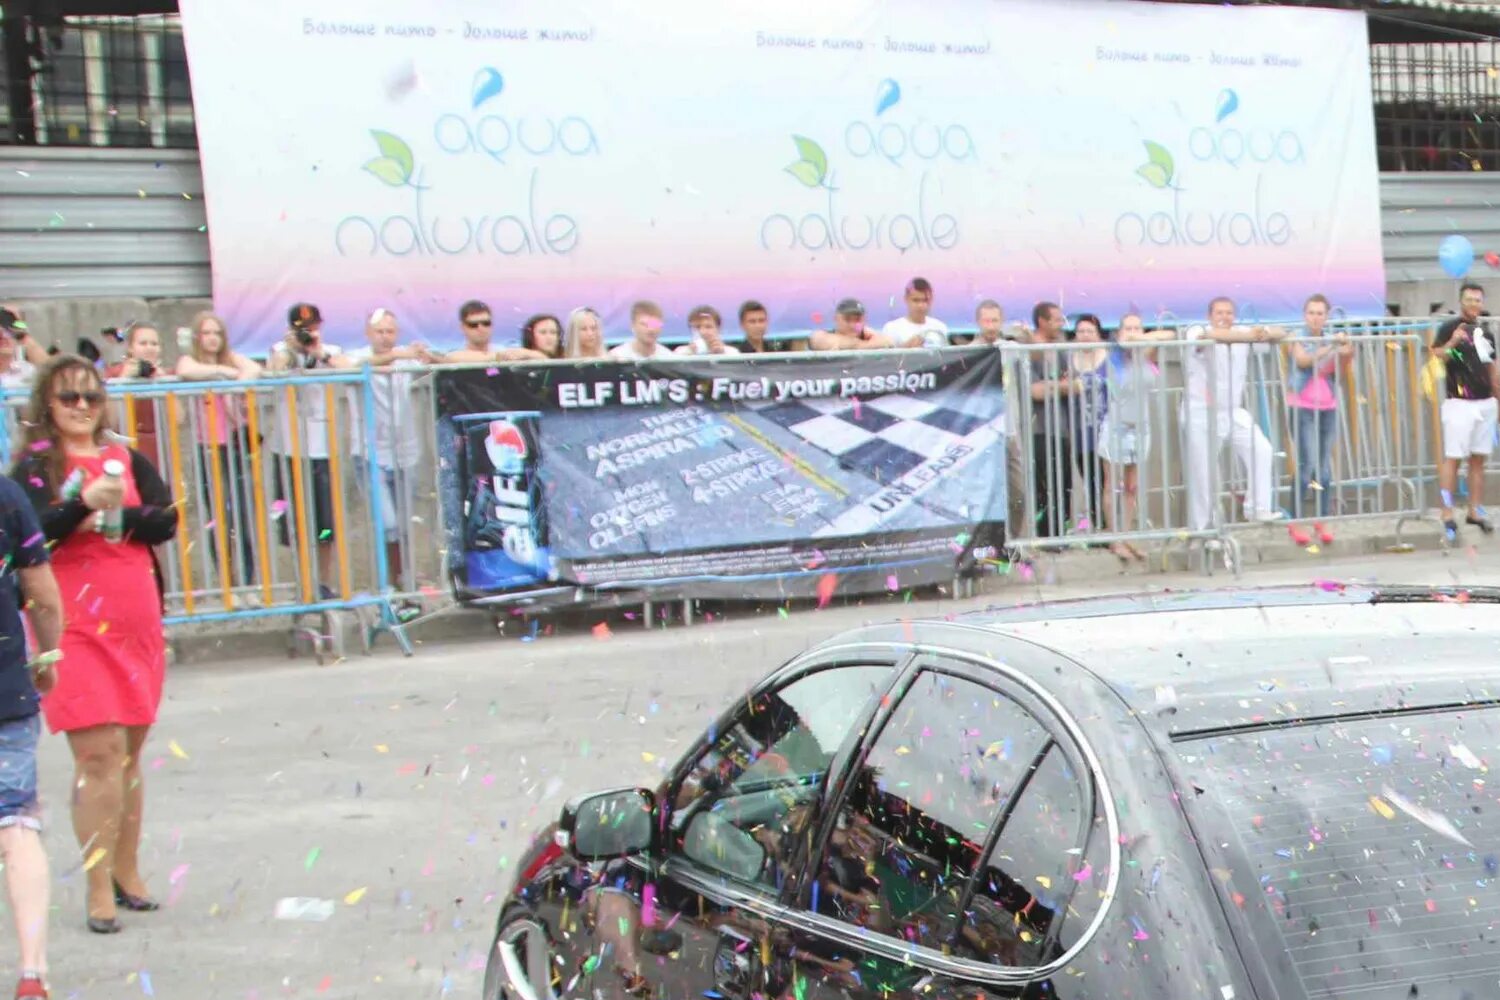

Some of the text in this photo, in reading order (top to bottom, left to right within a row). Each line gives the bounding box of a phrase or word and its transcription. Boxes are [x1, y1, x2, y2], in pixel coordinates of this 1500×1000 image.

[335, 165, 579, 256] naturale
[761, 168, 959, 251] naturale
[1114, 171, 1292, 247] naturale
[558, 381, 613, 408] ELF
[711, 376, 770, 401] Fuel
[774, 376, 837, 404] your
[840, 370, 937, 399] passion
[596, 424, 736, 478] ASPIRATD
